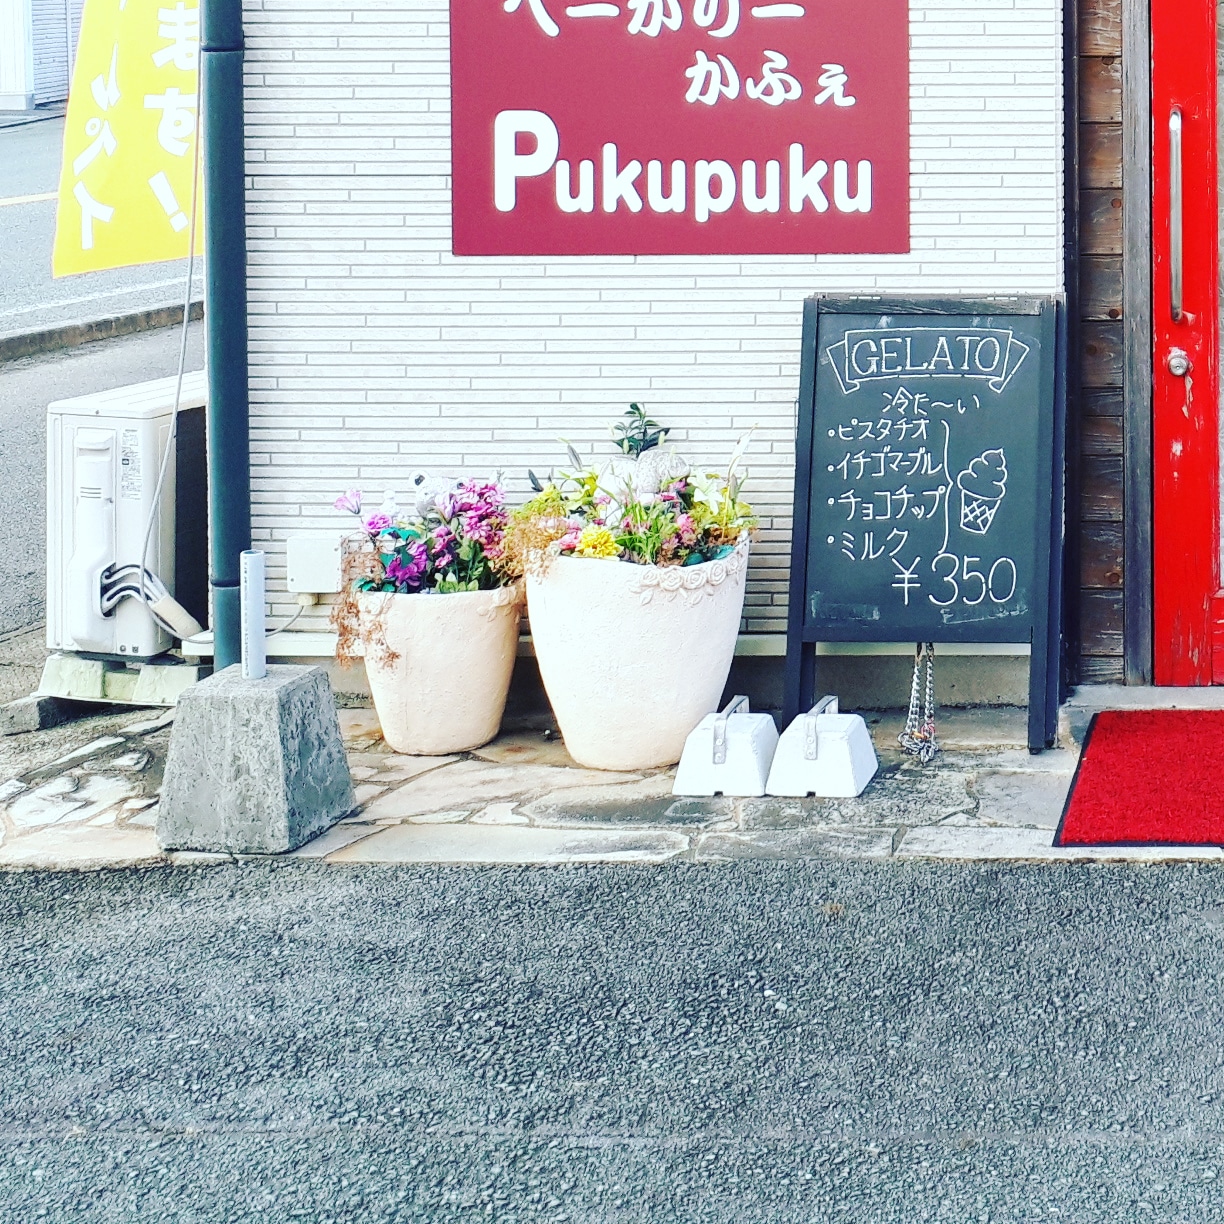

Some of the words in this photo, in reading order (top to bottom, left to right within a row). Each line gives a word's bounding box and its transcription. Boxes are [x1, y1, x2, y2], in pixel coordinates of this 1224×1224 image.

[684, 50, 857, 107] かふぇ
[493, 109, 873, 223] Pukupuku
[851, 335, 1001, 376] GELATO
[838, 418, 930, 441] ピスタチオ
[837, 444, 943, 480] イチゴマーブル
[837, 484, 947, 521] チョコチップ
[840, 527, 909, 561] ミルク
